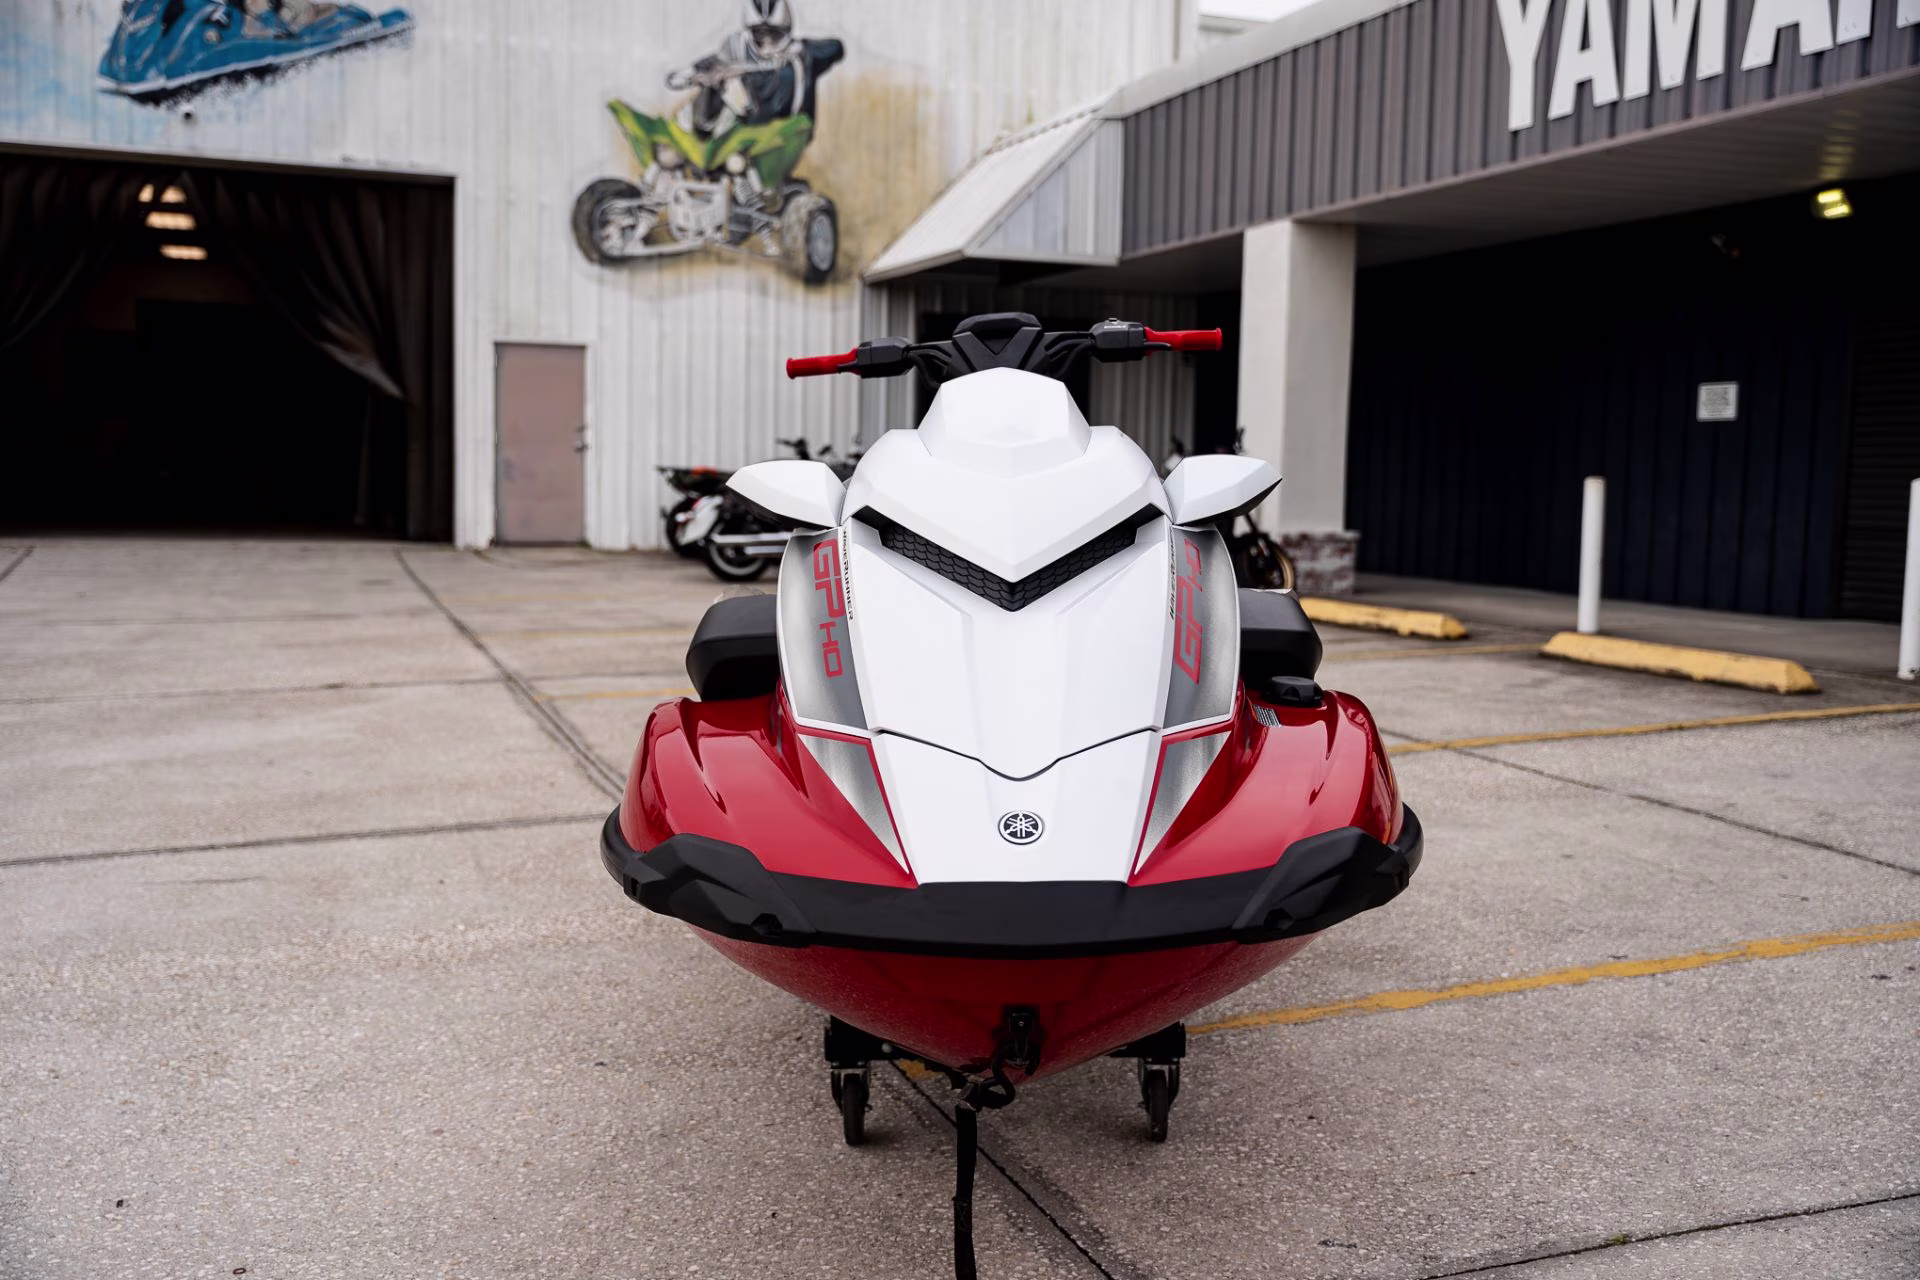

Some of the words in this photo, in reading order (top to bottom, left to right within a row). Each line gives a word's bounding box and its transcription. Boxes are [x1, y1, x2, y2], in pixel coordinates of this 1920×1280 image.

[1496, 0, 1920, 132] YAM
[813, 538, 847, 619] GP
[819, 621, 843, 678] HO
